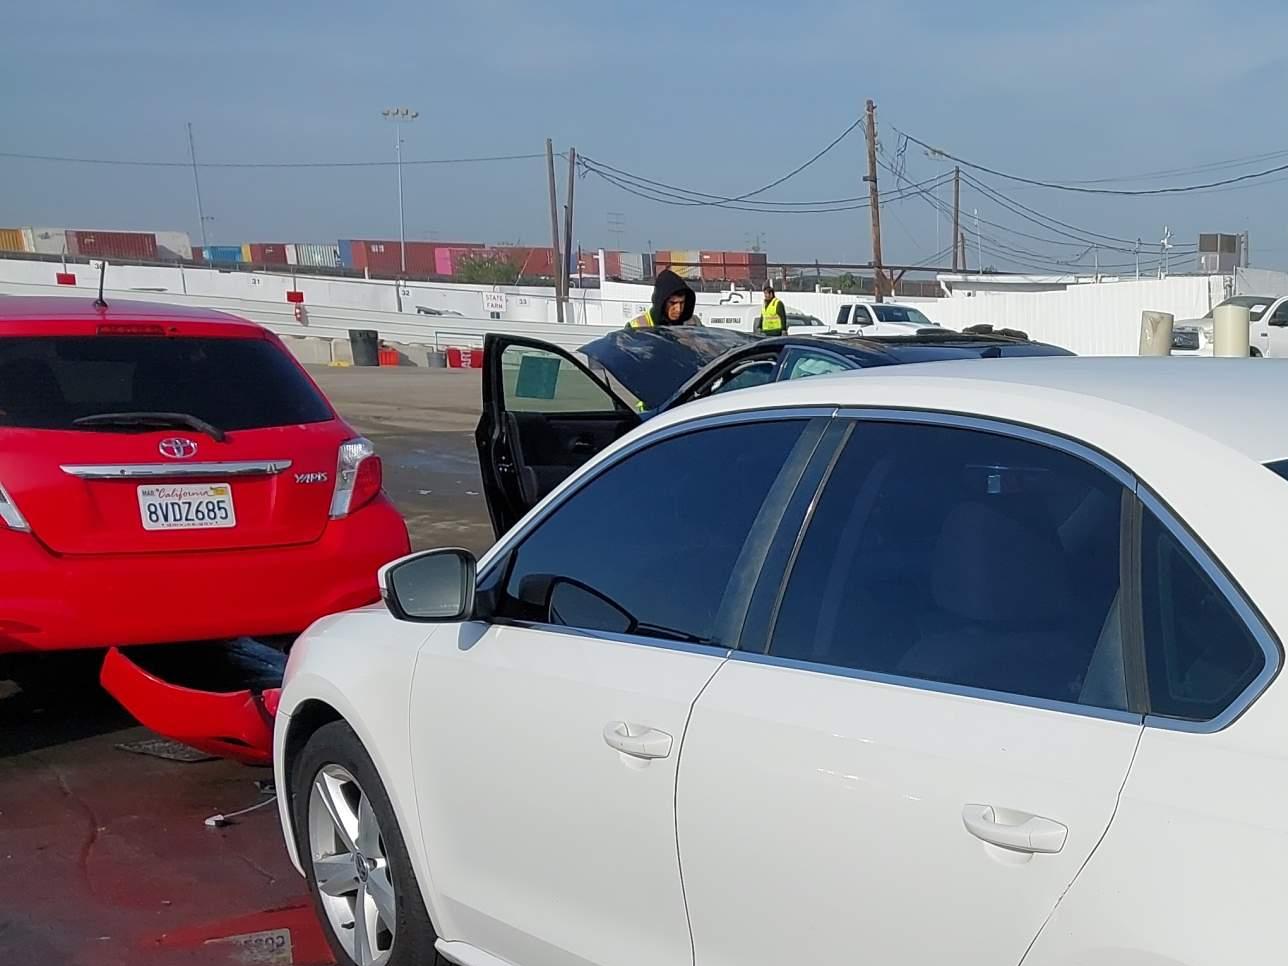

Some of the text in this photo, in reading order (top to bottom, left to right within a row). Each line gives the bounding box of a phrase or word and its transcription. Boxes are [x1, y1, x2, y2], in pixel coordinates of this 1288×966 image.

[486, 294, 503, 302] STATE
[294, 472, 328, 484] YARIS
[158, 487, 212, 502] California
[147, 500, 229, 524] 8VDZ685
